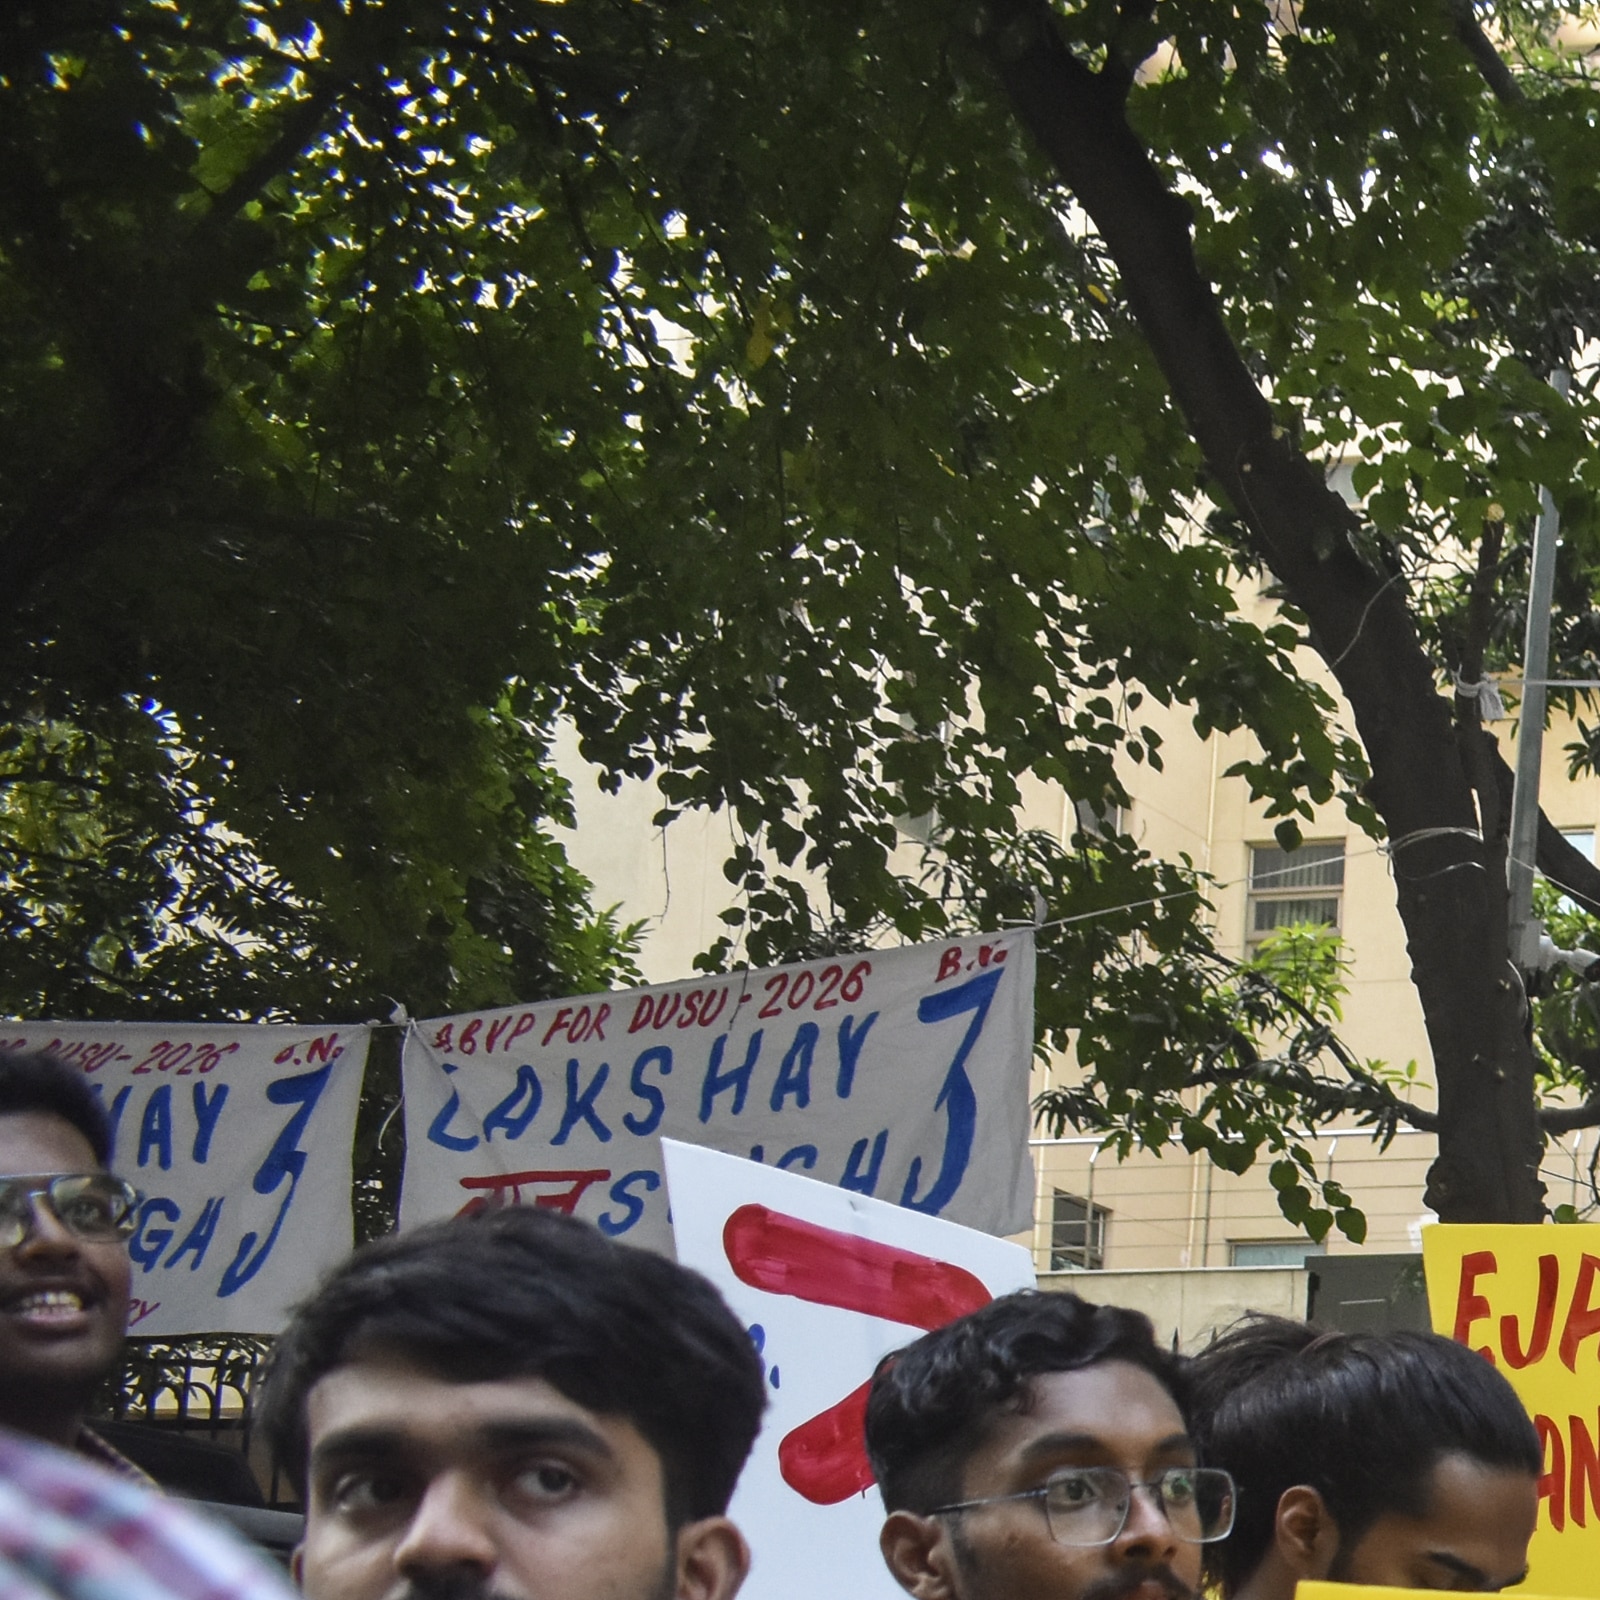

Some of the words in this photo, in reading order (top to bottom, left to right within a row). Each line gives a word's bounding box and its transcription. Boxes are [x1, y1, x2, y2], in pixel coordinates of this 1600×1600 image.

[432, 1014, 535, 1055] ABVP
[542, 1004, 613, 1047] FOR
[427, 1011, 880, 1151] LAKSHAY
